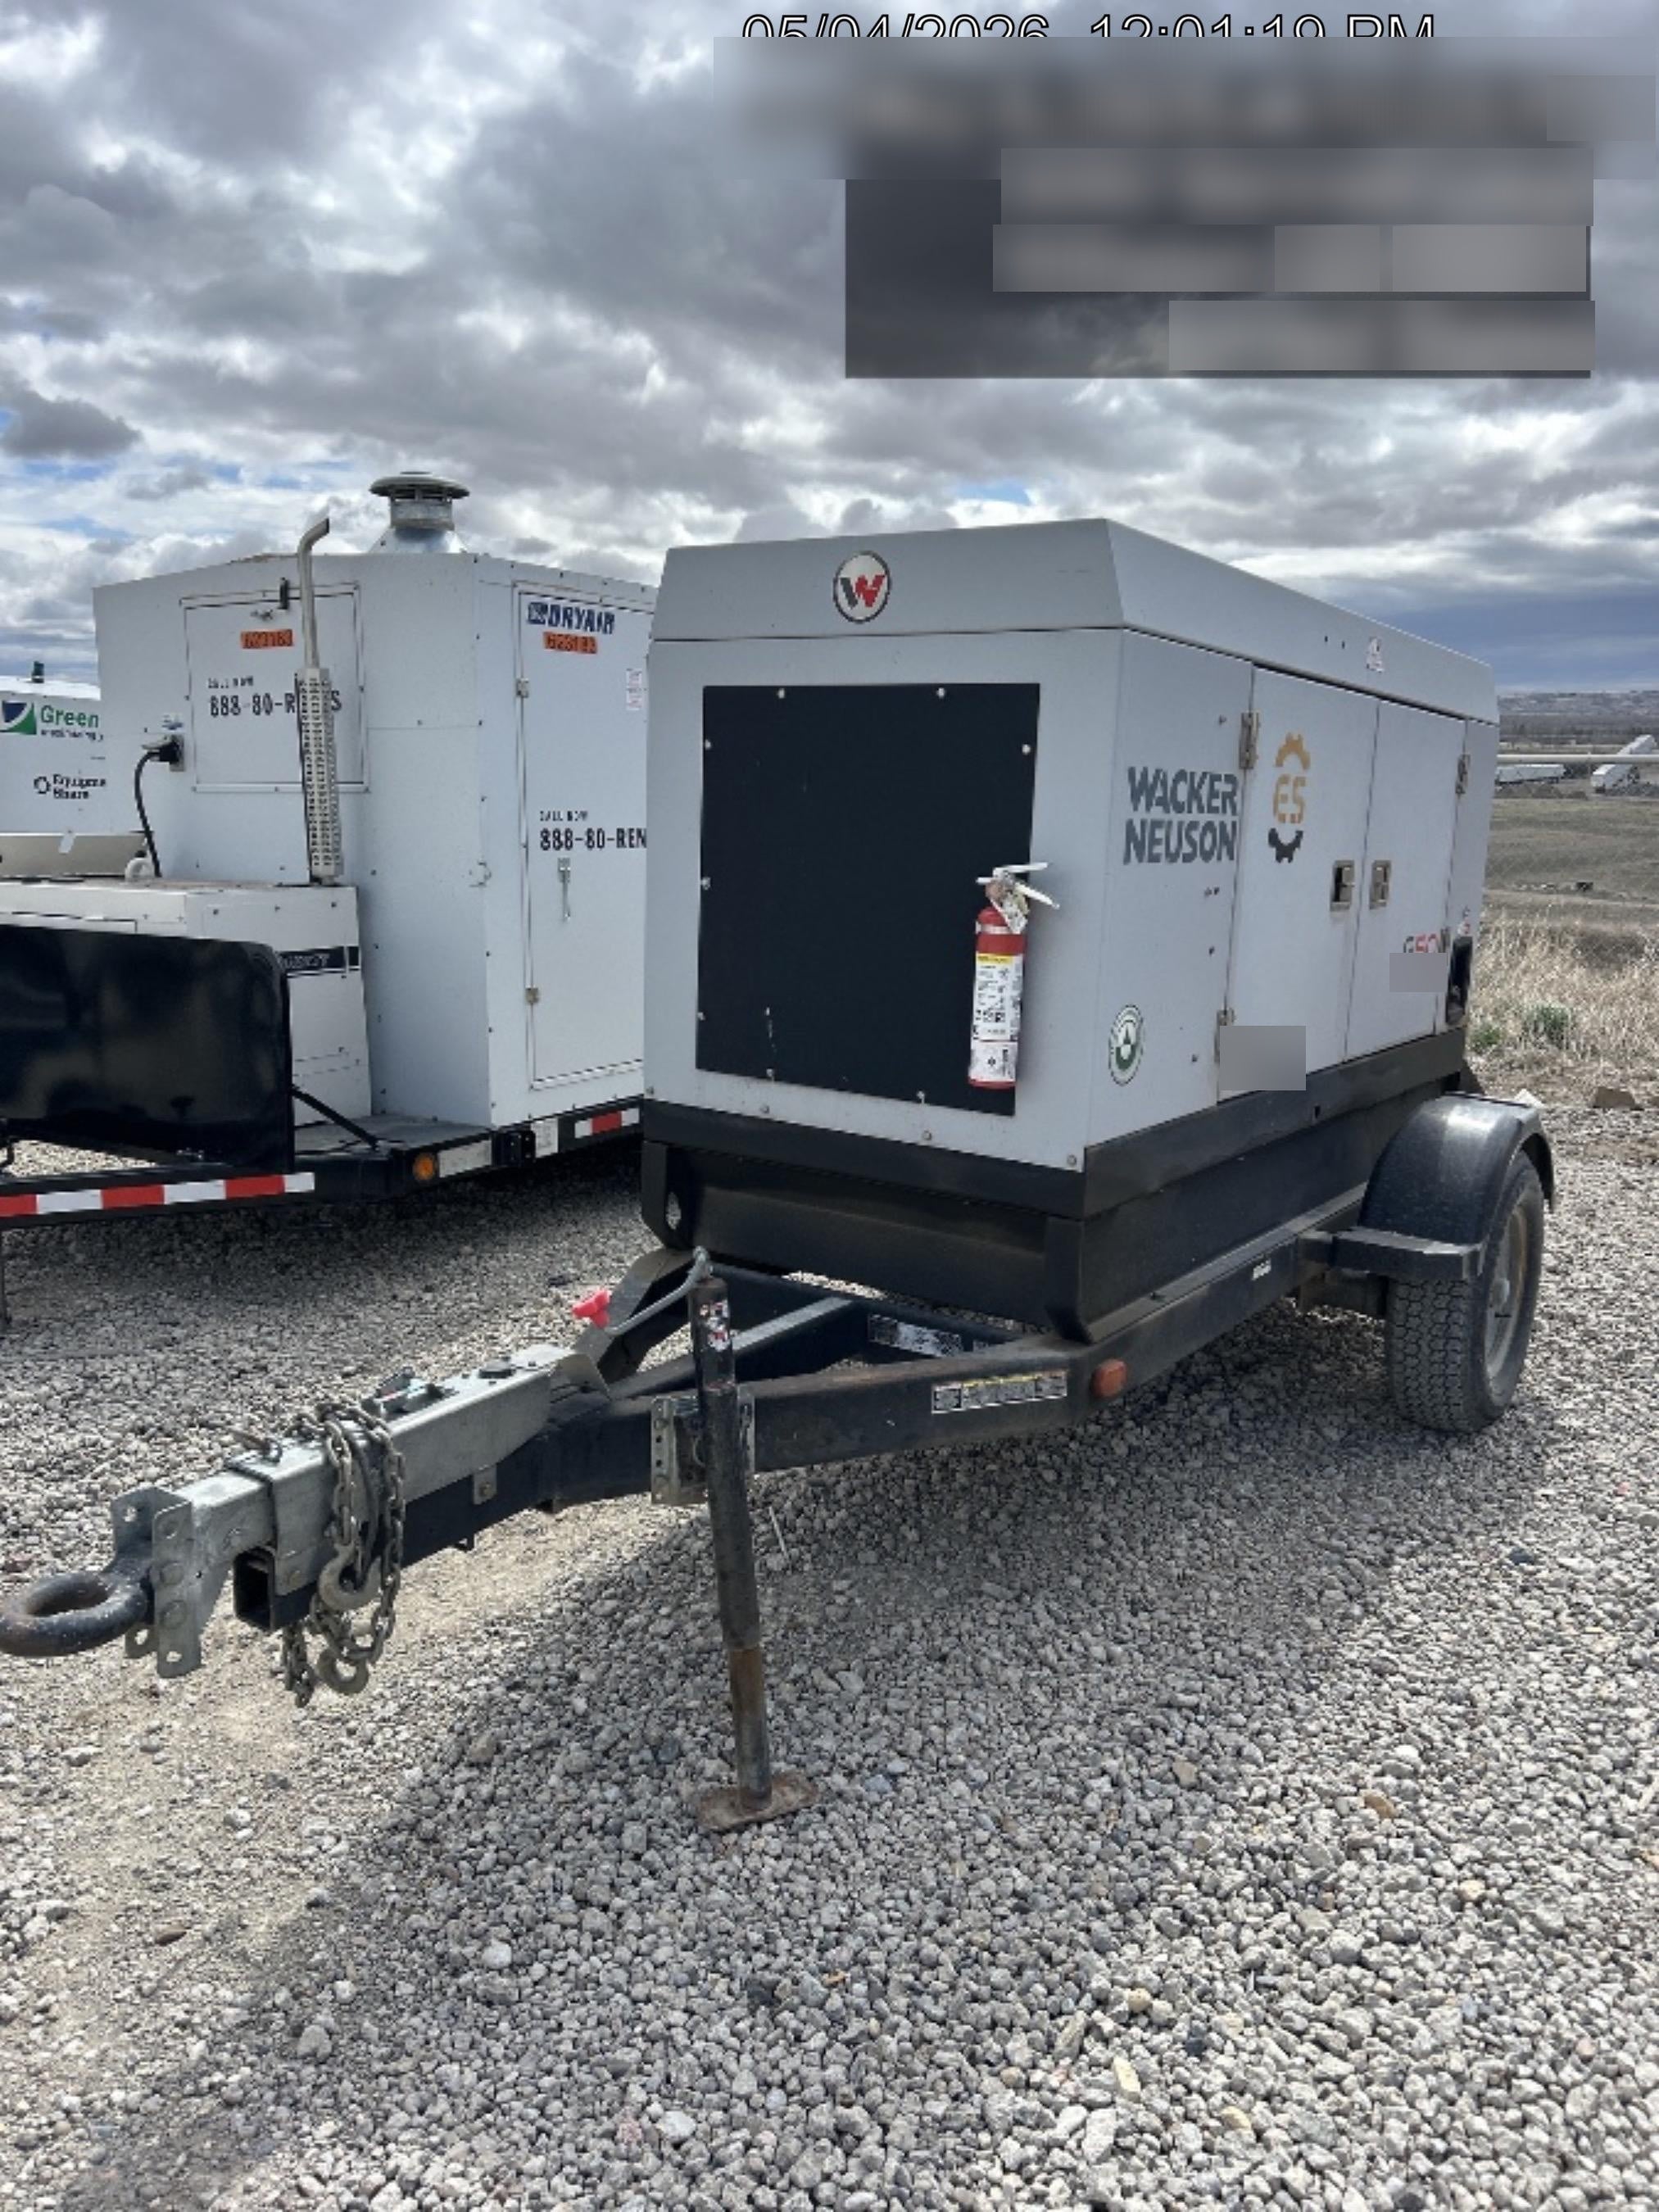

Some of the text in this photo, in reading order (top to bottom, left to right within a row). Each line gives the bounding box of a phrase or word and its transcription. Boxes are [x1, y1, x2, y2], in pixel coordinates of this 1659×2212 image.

[548, 605, 614, 635] DRYAIR
[41, 705, 98, 728] Green
[1127, 766, 1239, 817] WACKER
[1273, 775, 1307, 824] ES
[1123, 818, 1237, 866] NEUSON
